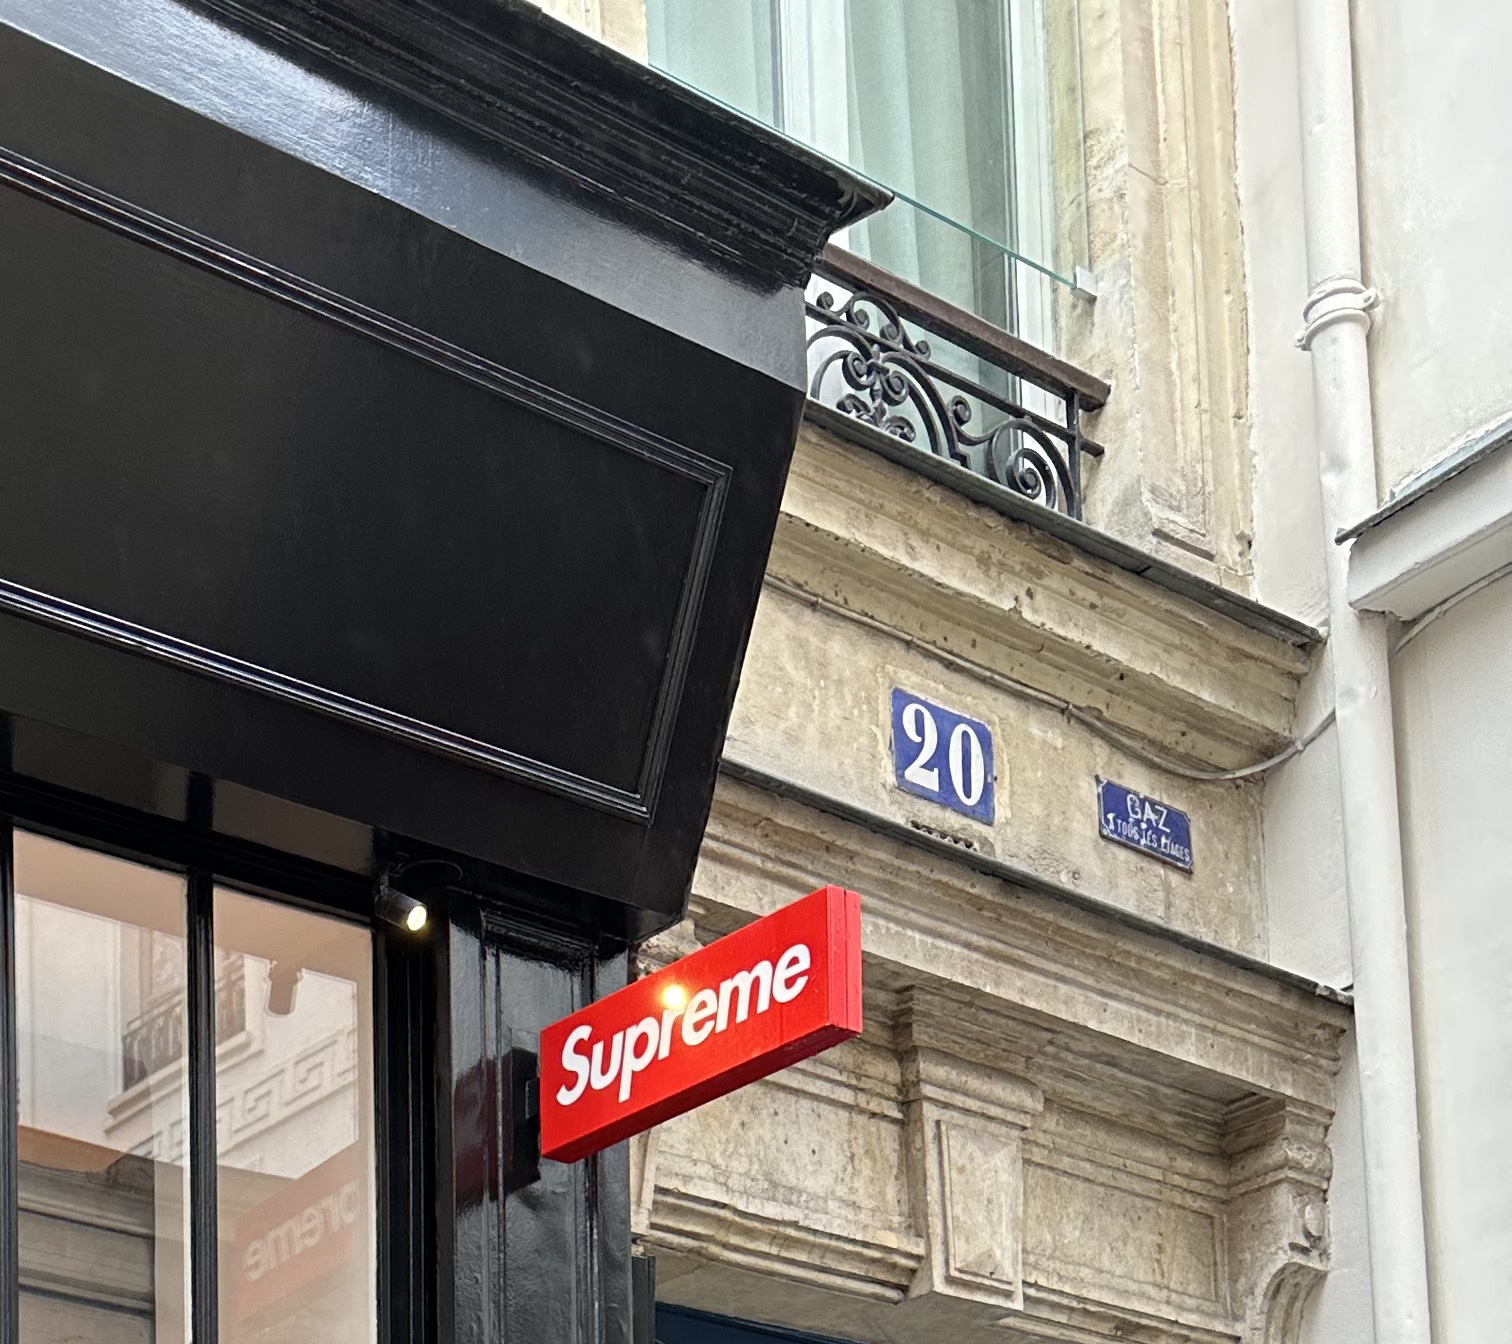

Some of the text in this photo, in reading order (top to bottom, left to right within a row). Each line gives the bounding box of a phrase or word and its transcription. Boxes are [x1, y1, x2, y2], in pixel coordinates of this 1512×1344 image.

[902, 702, 985, 806] 20
[1126, 794, 1170, 833] GAZ
[556, 943, 812, 1106] Supreme
